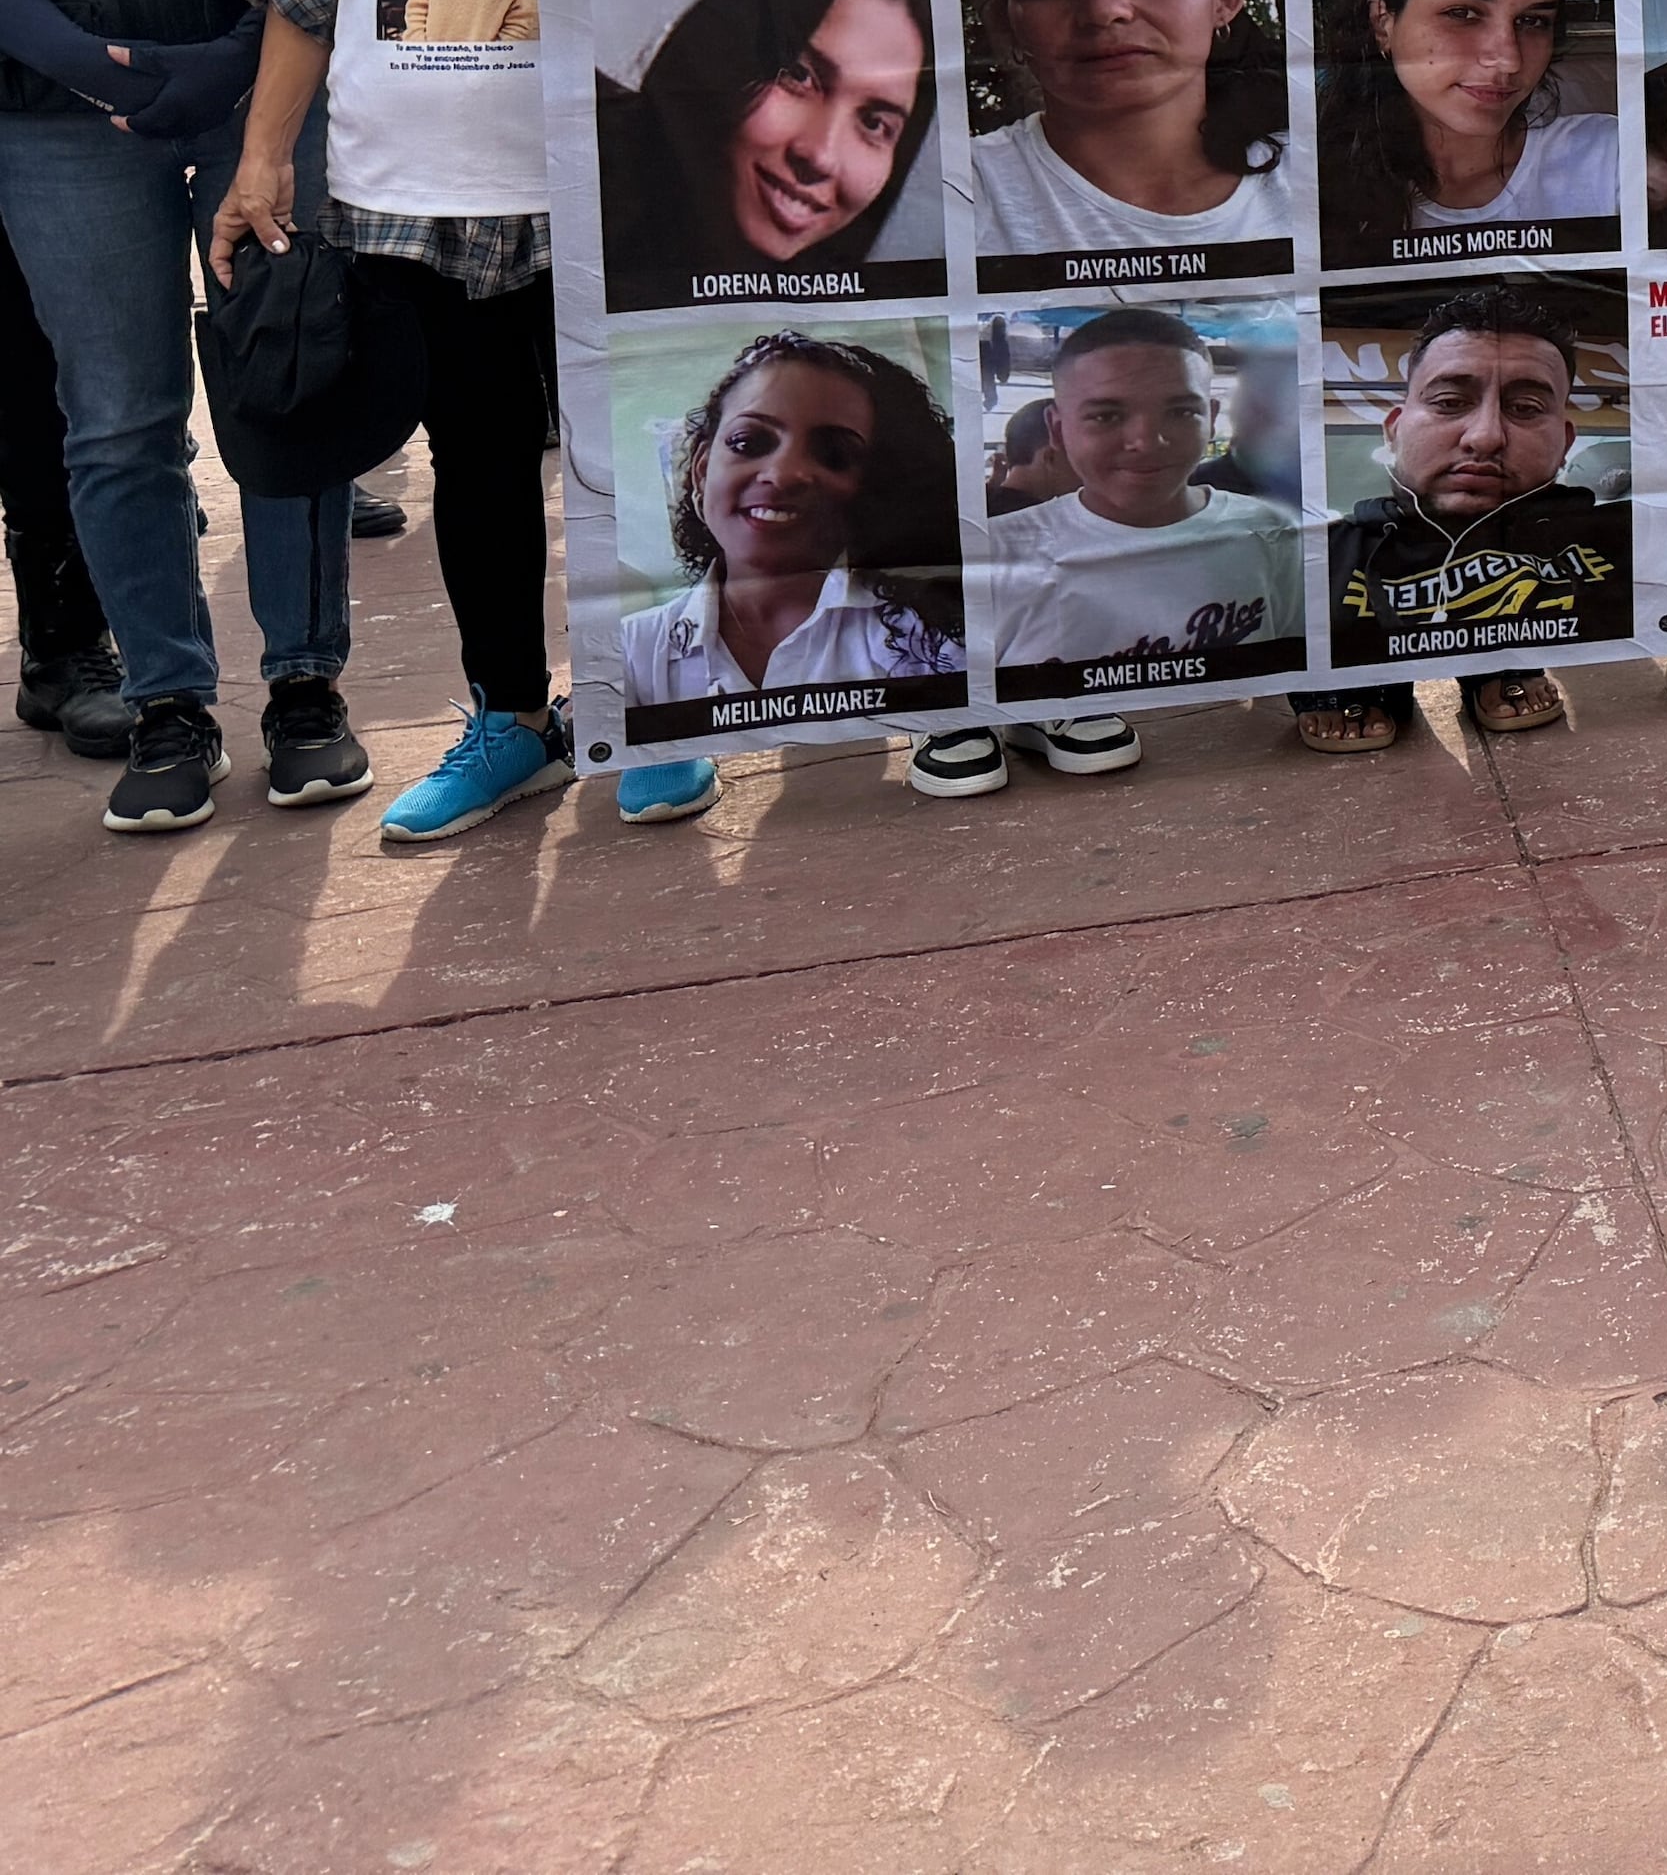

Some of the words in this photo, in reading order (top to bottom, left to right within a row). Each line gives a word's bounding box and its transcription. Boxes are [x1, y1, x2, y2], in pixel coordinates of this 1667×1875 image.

[485, 43, 514, 52] busco
[411, 62, 451, 70] Poderoso
[453, 62, 490, 70] Nombre
[492, 62, 504, 70] de
[507, 61, 536, 70] Jesús
[1392, 233, 1462, 259] ELIANIS
[1466, 225, 1553, 252] MOREJÓN
[1065, 255, 1164, 281] DAYRANIS
[1168, 252, 1206, 275] TAN
[692, 273, 772, 298] LORENA
[776, 271, 866, 296] ROSABAL
[1388, 627, 1469, 656] RICARDO
[1473, 617, 1579, 648] HERNÁNDEZ
[1082, 663, 1142, 689] SAMEI
[1147, 656, 1206, 682] REYES
[712, 695, 796, 727] MEILING
[801, 687, 887, 716] ALVAREZ
